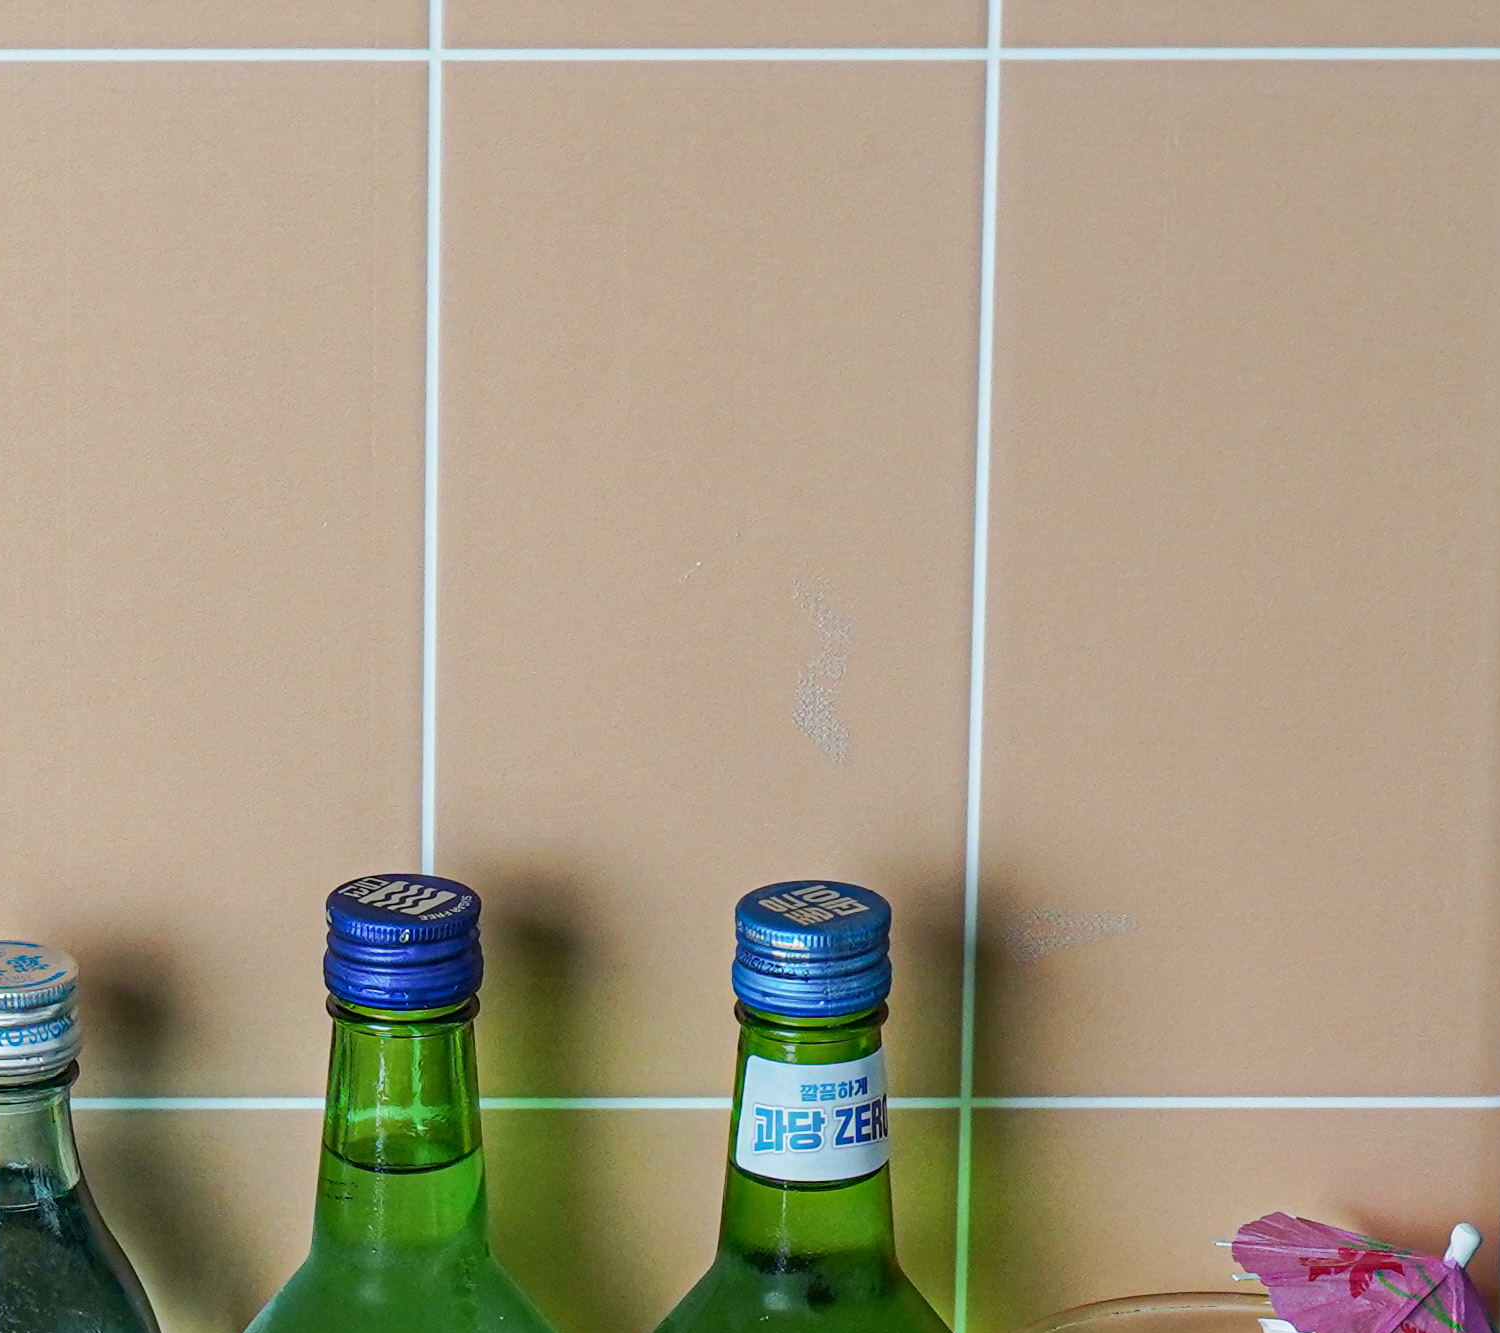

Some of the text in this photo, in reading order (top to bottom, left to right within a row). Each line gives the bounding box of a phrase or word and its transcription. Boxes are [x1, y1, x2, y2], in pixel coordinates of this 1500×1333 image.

[801, 1077, 868, 1101] 깔끔하게
[754, 1093, 888, 1151] 과당 ZERO
